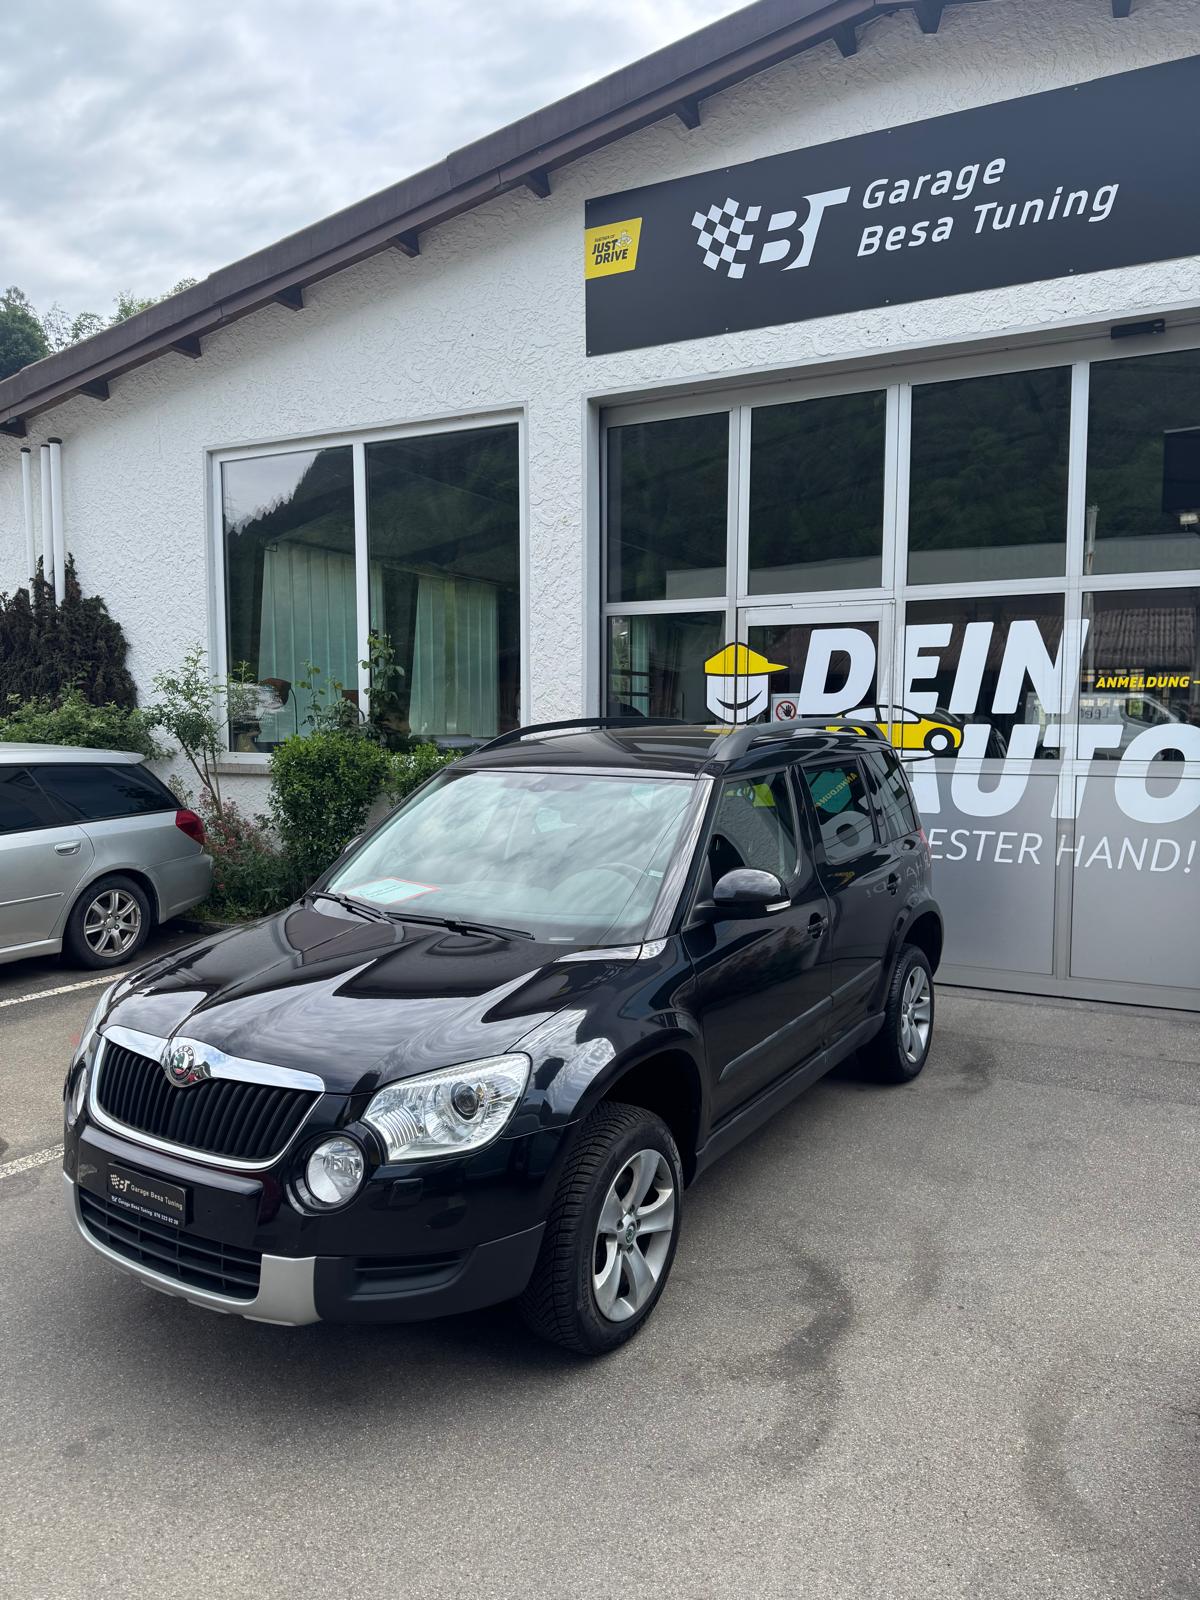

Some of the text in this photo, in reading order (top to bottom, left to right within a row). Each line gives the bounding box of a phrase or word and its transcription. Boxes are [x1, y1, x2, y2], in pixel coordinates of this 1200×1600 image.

[862, 157, 1006, 209] Garage
[857, 183, 1120, 257] Besa Tuning
[592, 239, 618, 255] JUST
[595, 249, 628, 265] DRIVE
[801, 619, 1089, 714] DEIN
[1095, 676, 1190, 689] ANMELDUNG
[928, 828, 1197, 874] ESTER HAND!
[130, 1184, 149, 1197] Garage
[150, 1191, 164, 1203] Besa
[164, 1196, 183, 1211] Tuning
